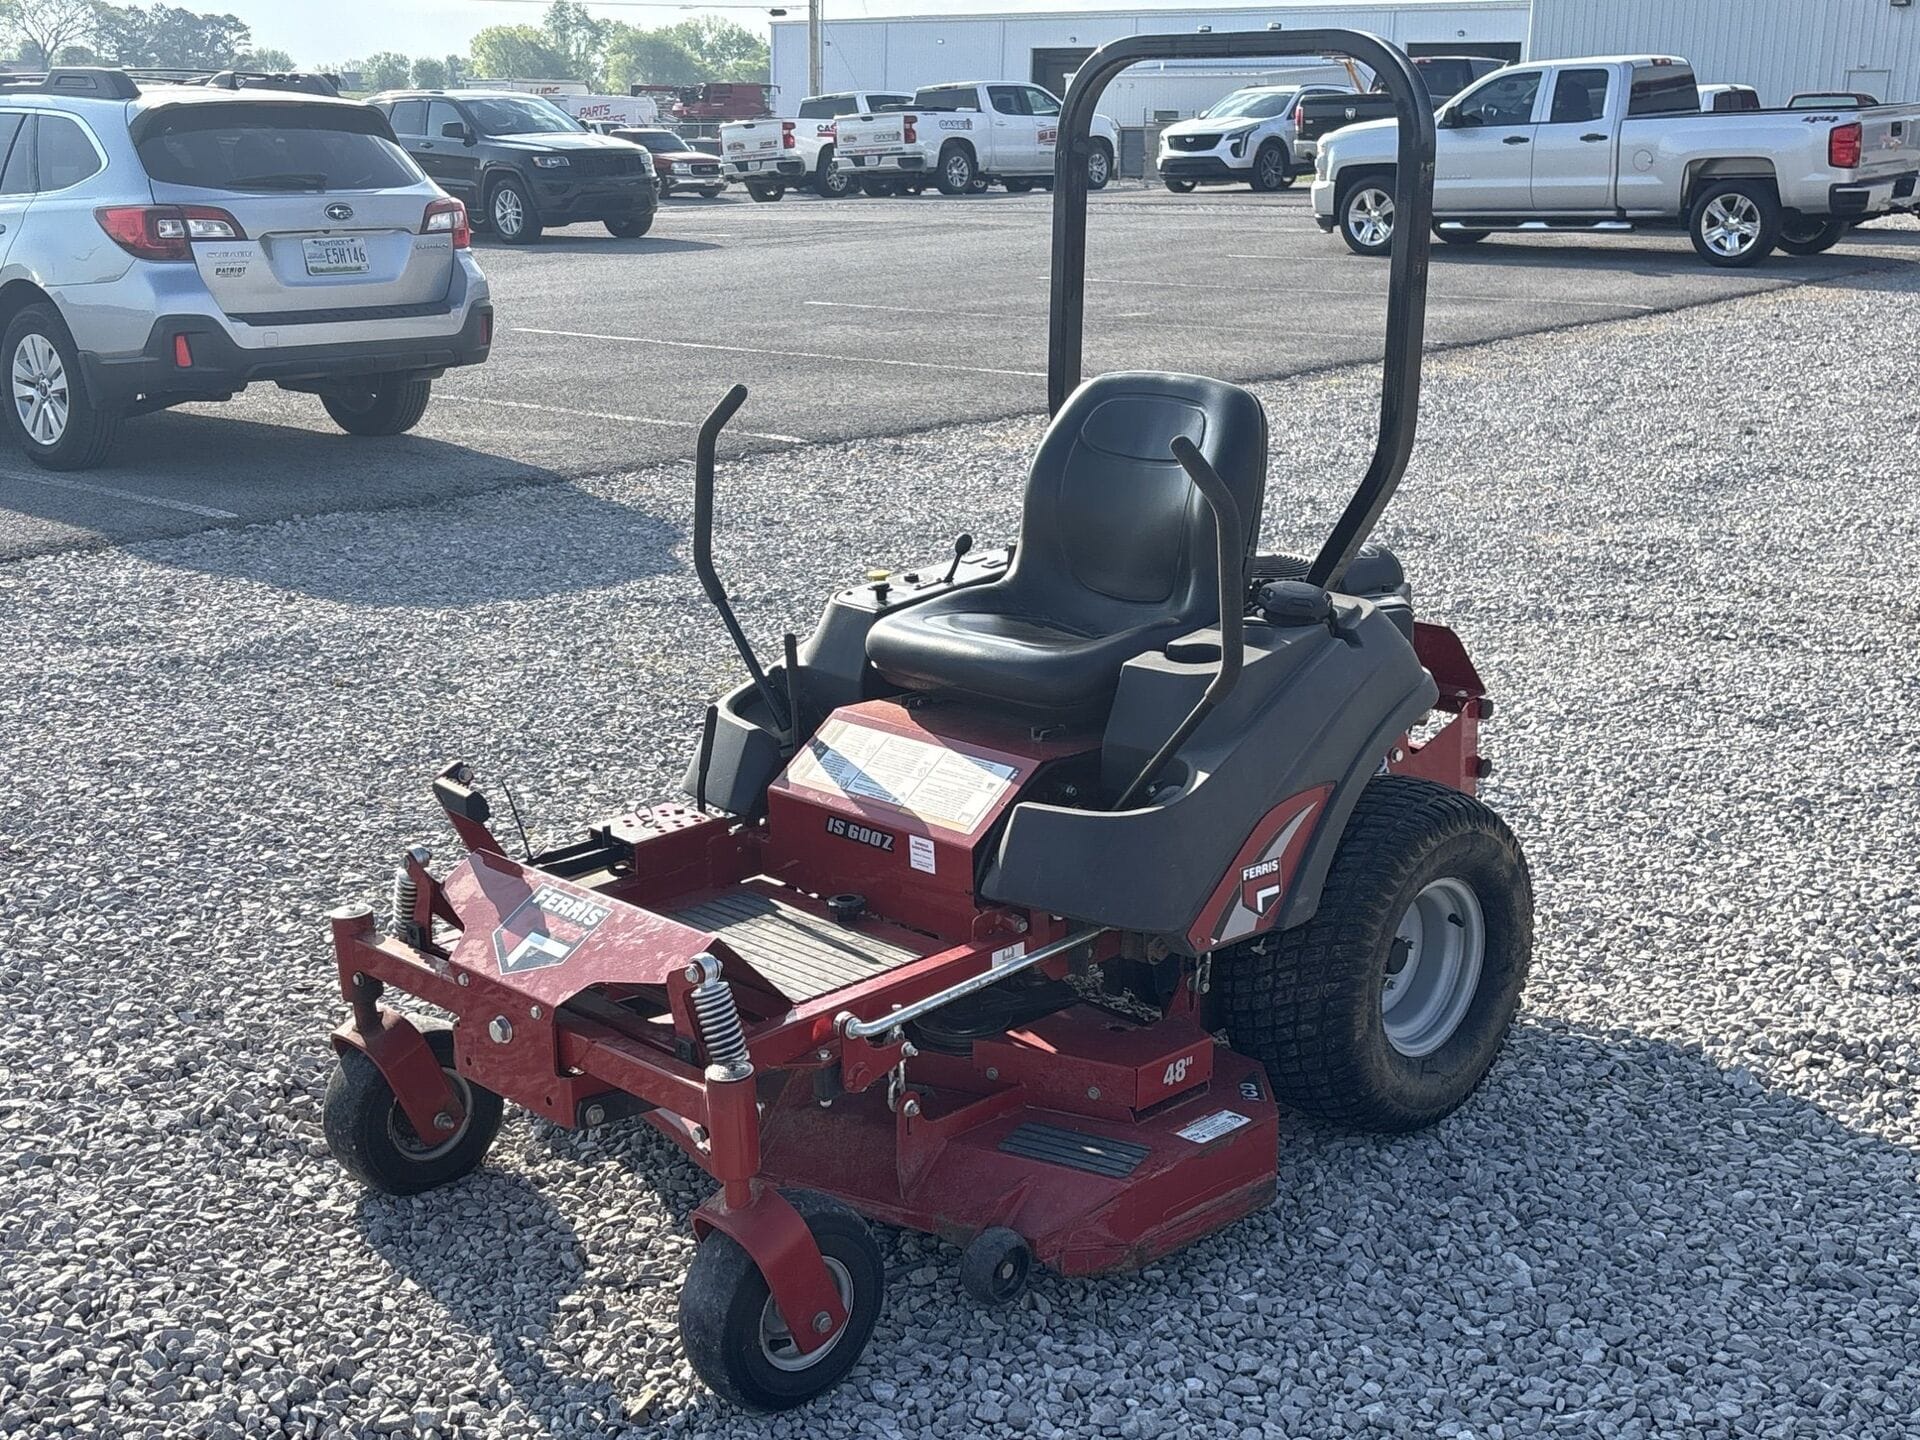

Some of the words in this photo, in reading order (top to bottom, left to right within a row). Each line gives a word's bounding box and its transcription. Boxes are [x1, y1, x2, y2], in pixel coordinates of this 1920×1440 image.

[579, 104, 611, 118] PARTS
[816, 124, 836, 133] CAS
[939, 119, 965, 130] CASE
[325, 247, 367, 264] E5H146
[215, 266, 247, 275] PATRIOT
[827, 817, 846, 835] IS
[848, 824, 894, 851] 600Z
[1242, 859, 1279, 881] FERRIS
[532, 888, 605, 926] FERRIS
[1162, 1056, 1194, 1086] 48"
